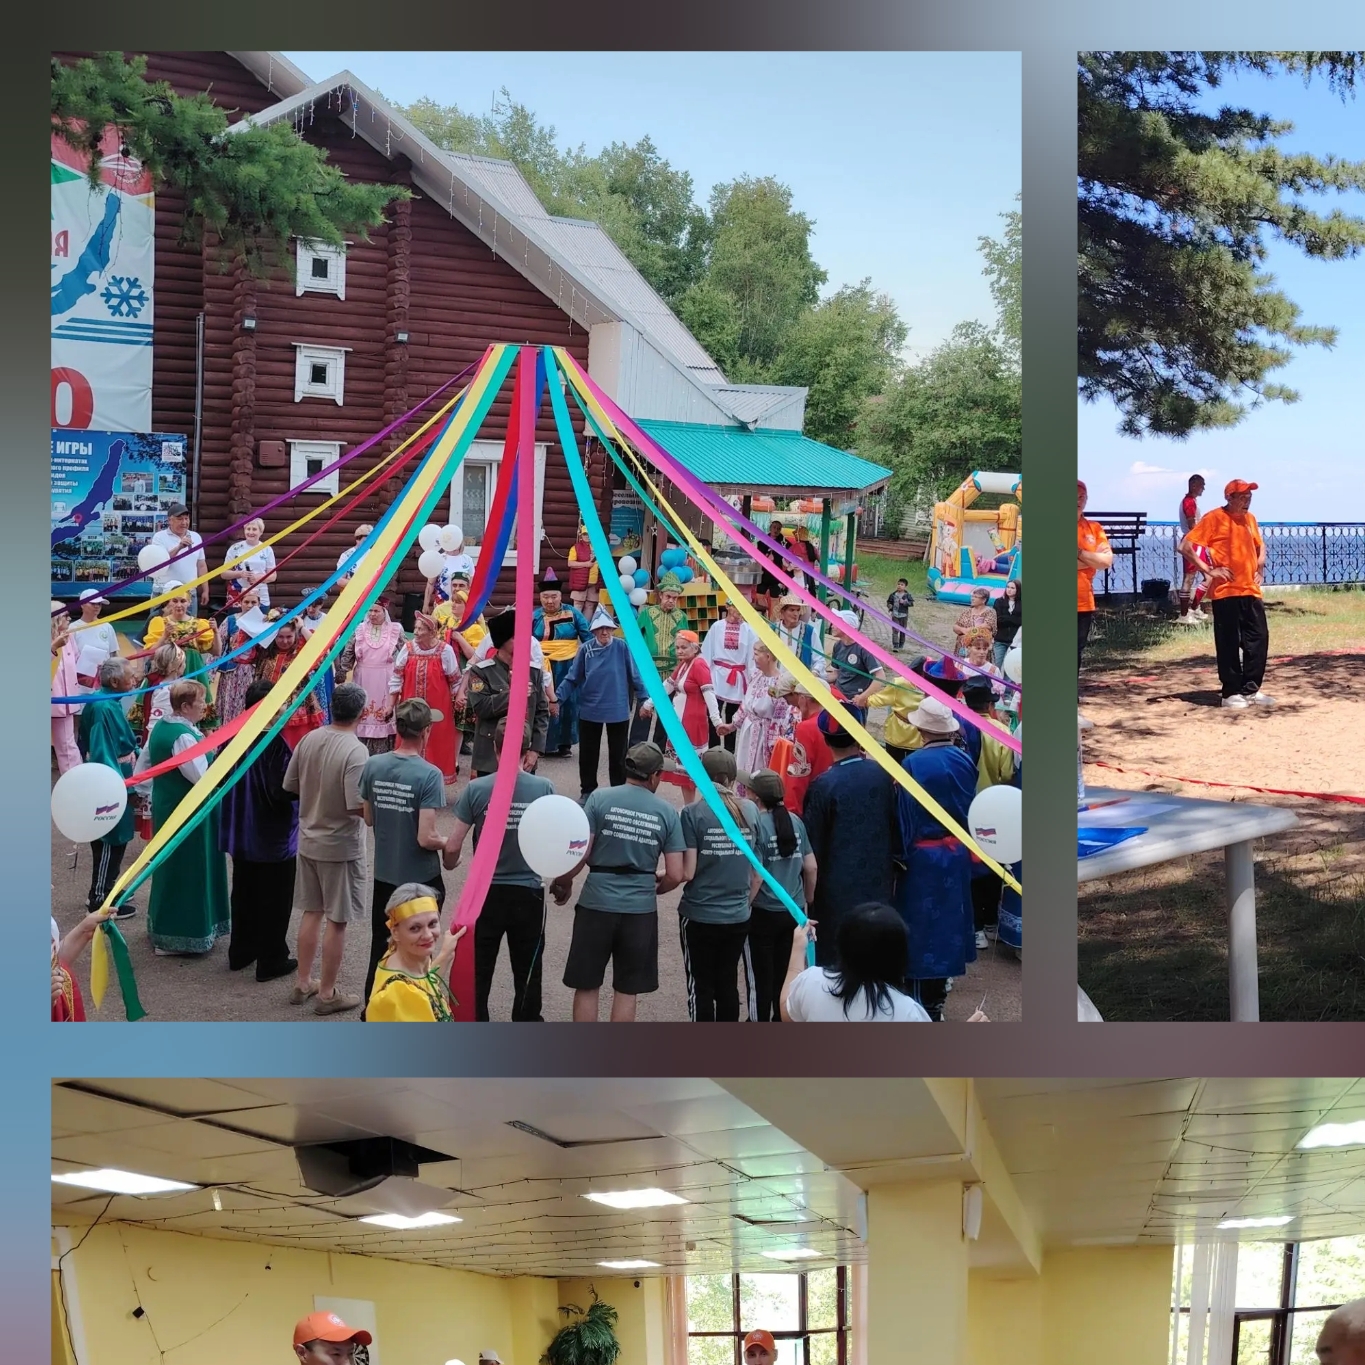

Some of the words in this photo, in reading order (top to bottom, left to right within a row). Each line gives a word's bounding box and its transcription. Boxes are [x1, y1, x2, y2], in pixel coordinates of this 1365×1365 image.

[56, 441, 93, 456] ИГРЫ
[604, 814, 632, 824] СОЦИАЛЬНОГО
[613, 830, 638, 842] СОЦИАЛЬНОЙ
